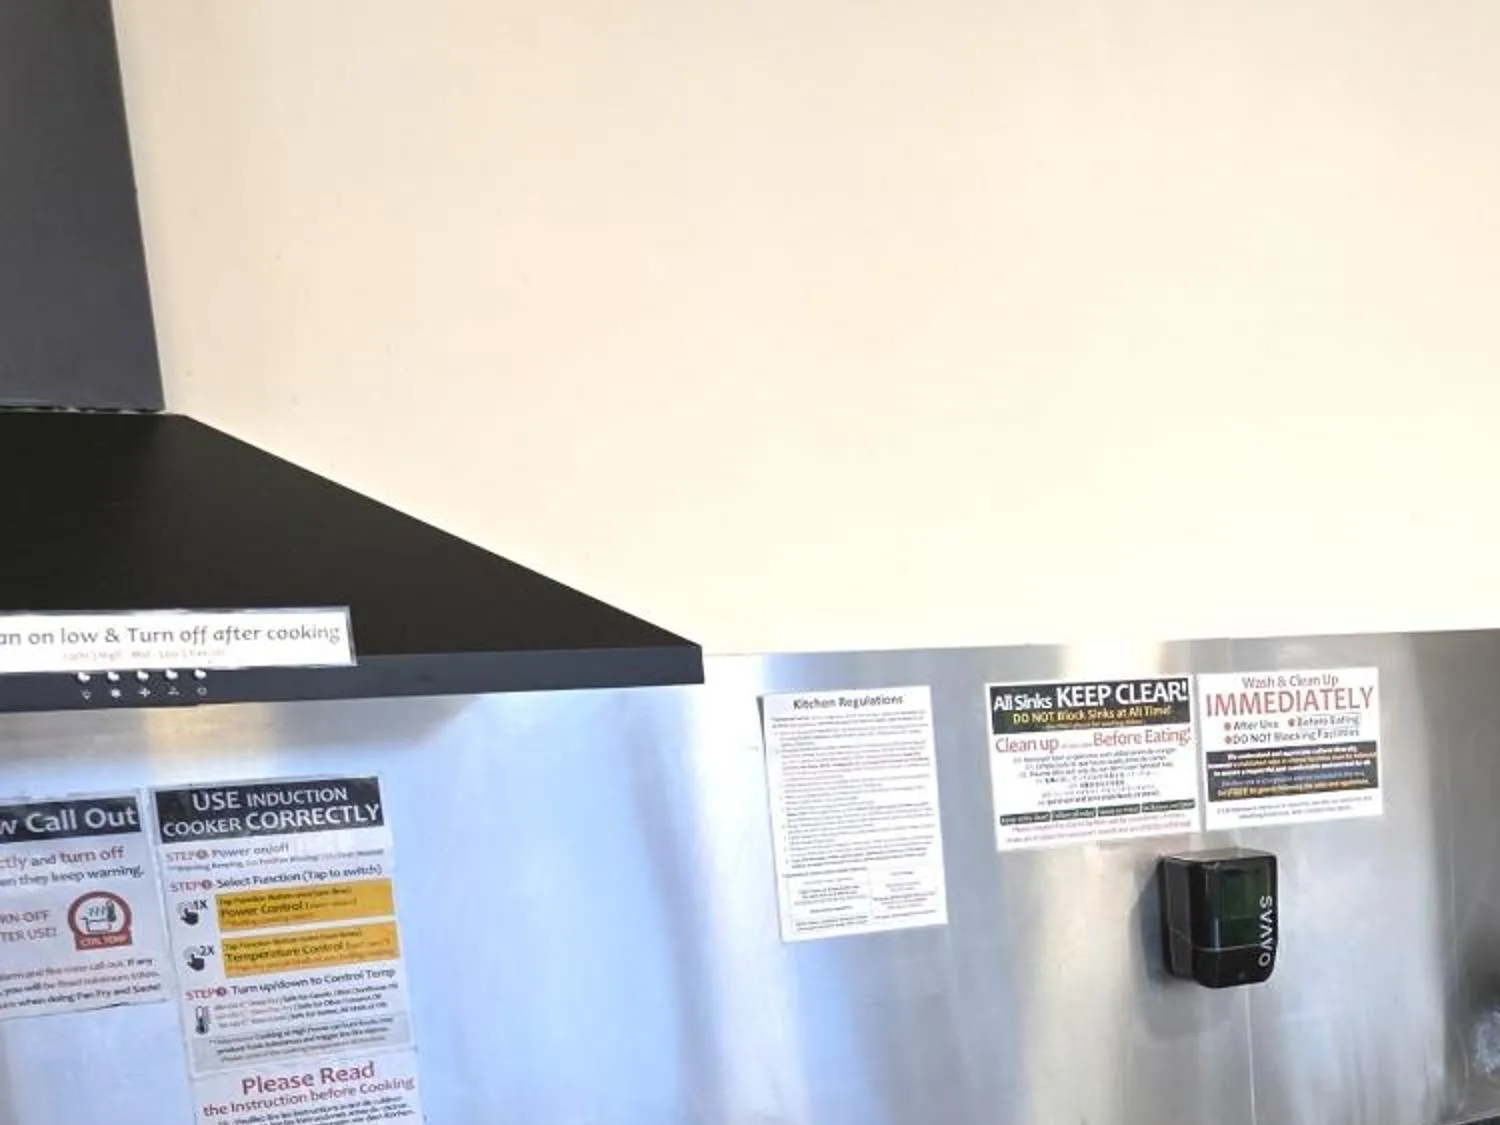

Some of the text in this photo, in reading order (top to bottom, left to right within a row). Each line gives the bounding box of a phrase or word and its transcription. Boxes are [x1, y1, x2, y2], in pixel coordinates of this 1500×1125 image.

[28, 630, 54, 646] on
[61, 627, 98, 645] low
[105, 627, 120, 644] &
[128, 626, 173, 644] Turn
[180, 624, 208, 645] off
[213, 624, 260, 645] after
[267, 623, 341, 644] cooking
[1241, 676, 1275, 689] Wash
[1289, 674, 1321, 688] Clean
[1323, 673, 1339, 689] Up
[793, 694, 904, 711] Kitchen Regulations
[993, 680, 1189, 711] All Sinks KEEP CLEAR!
[1206, 685, 1375, 718] IMMEDIATELY
[1031, 711, 1055, 724] NOT
[995, 737, 1038, 754] Clean
[1039, 737, 1060, 754] up
[1092, 731, 1143, 747] Before
[1144, 727, 1192, 746] Eating!
[191, 787, 348, 812] USE INDUCTION
[25, 807, 78, 834] Call
[84, 805, 138, 829] Out
[162, 803, 380, 838] COOKER CORRECTLY
[59, 850, 97, 865] turn
[99, 845, 125, 861] off
[241, 1060, 376, 1096] Please Read
[203, 1103, 228, 1118] the
[230, 1092, 309, 1114] Instruction
[309, 1084, 357, 1101] before
